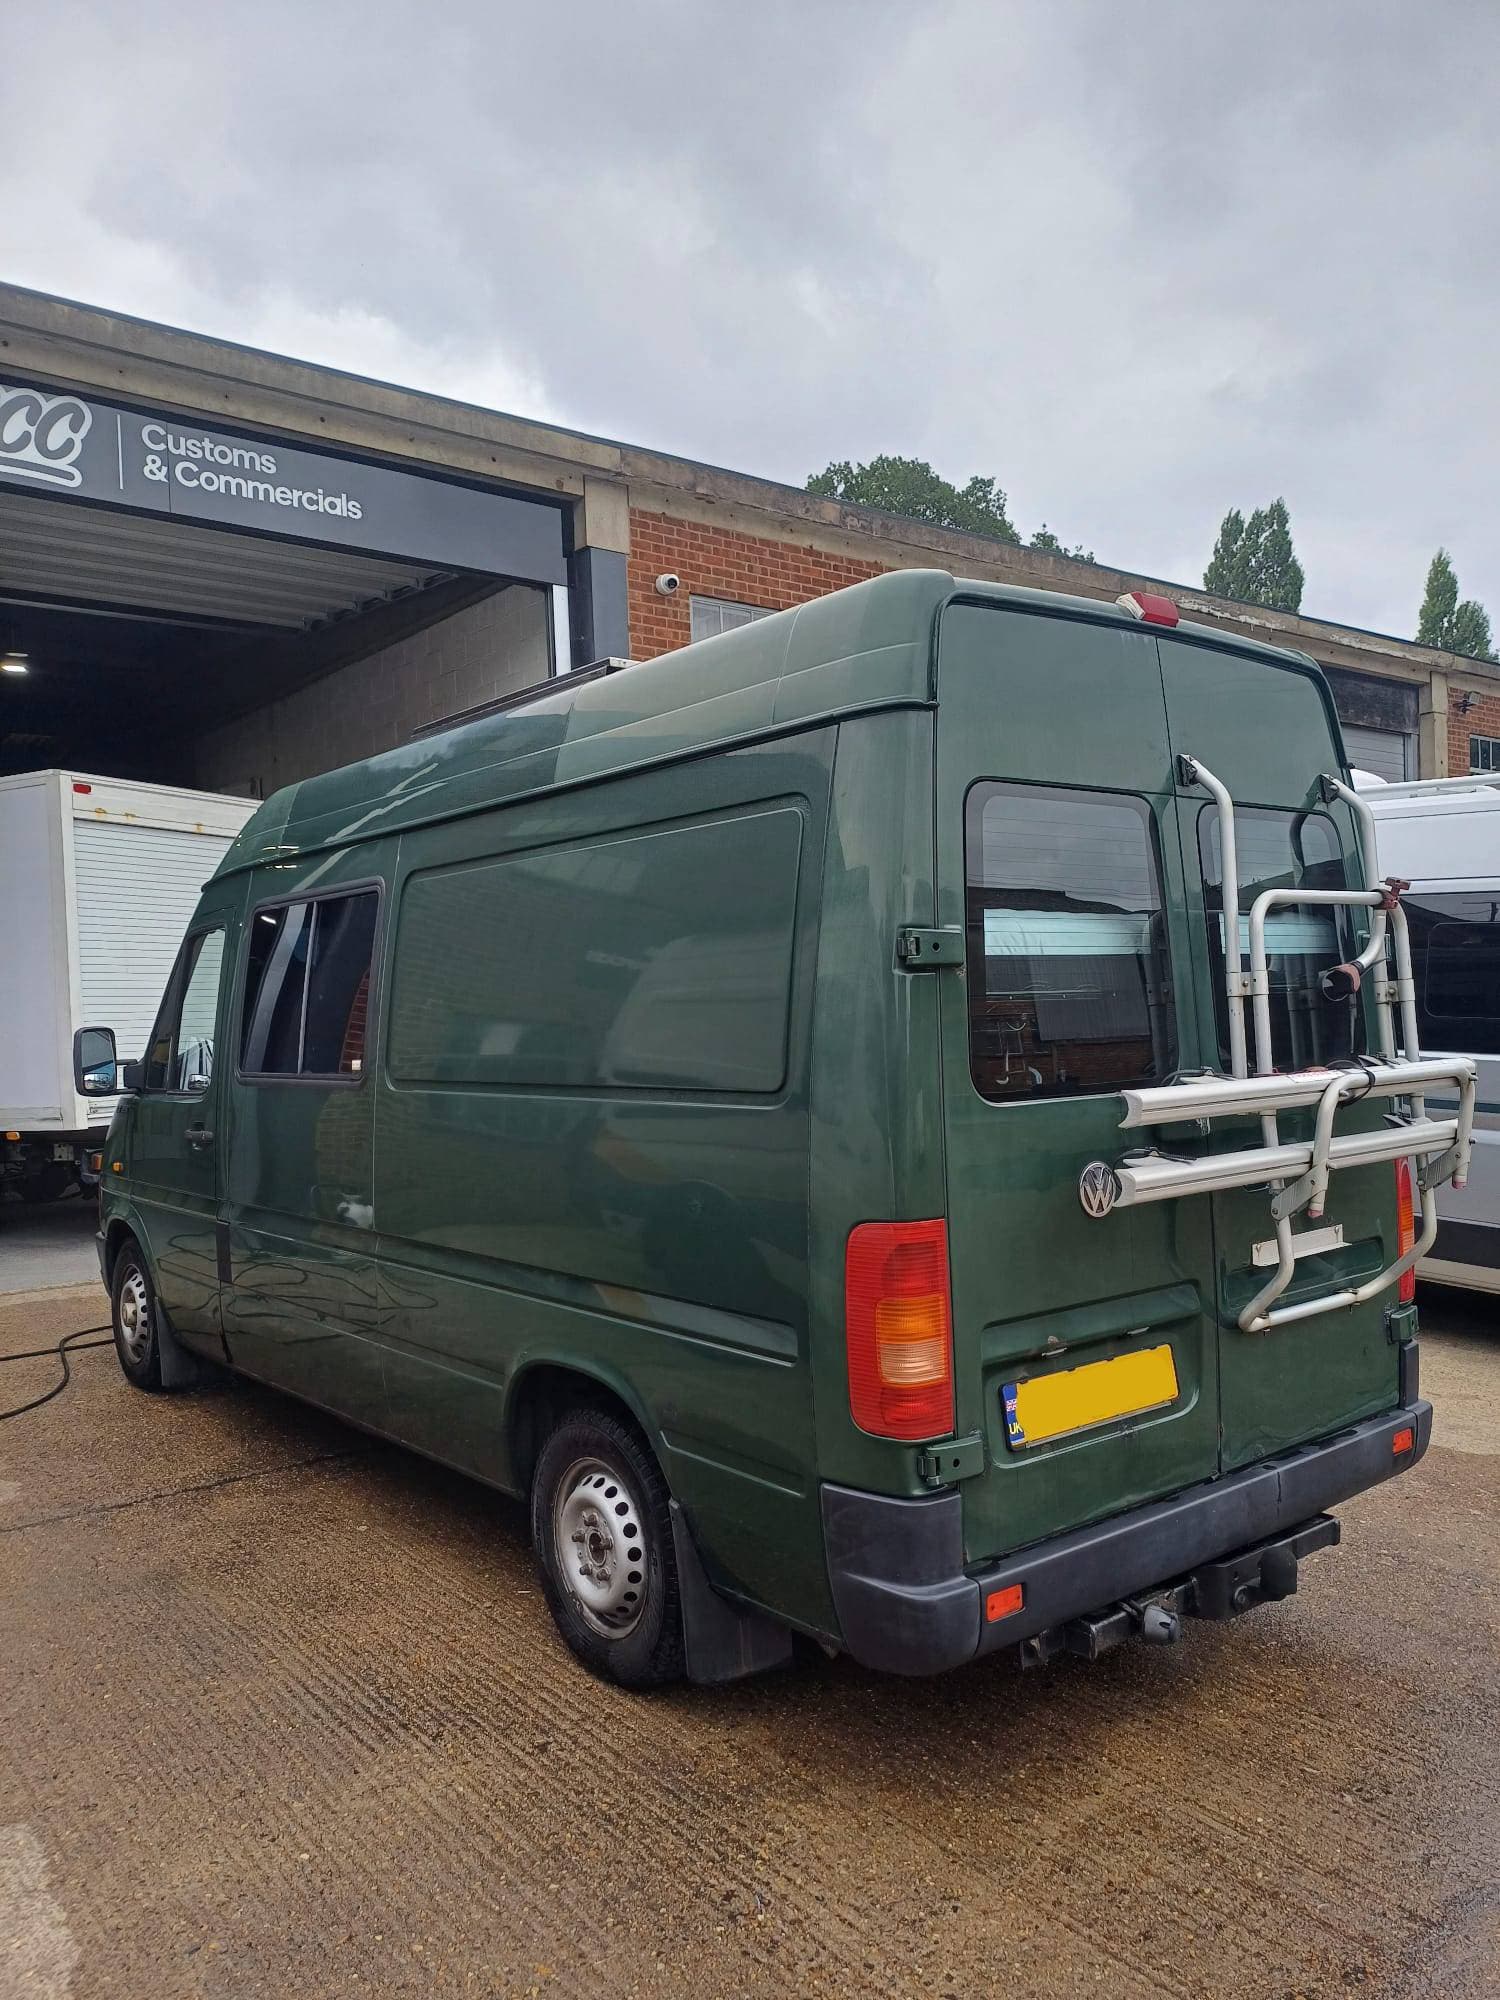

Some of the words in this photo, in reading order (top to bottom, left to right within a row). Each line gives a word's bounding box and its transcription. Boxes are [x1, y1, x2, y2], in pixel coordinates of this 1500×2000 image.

[141, 423, 277, 474] Customs
[143, 454, 168, 483] &
[174, 461, 363, 520] Commercials
[1008, 1422, 1024, 1435] UK
